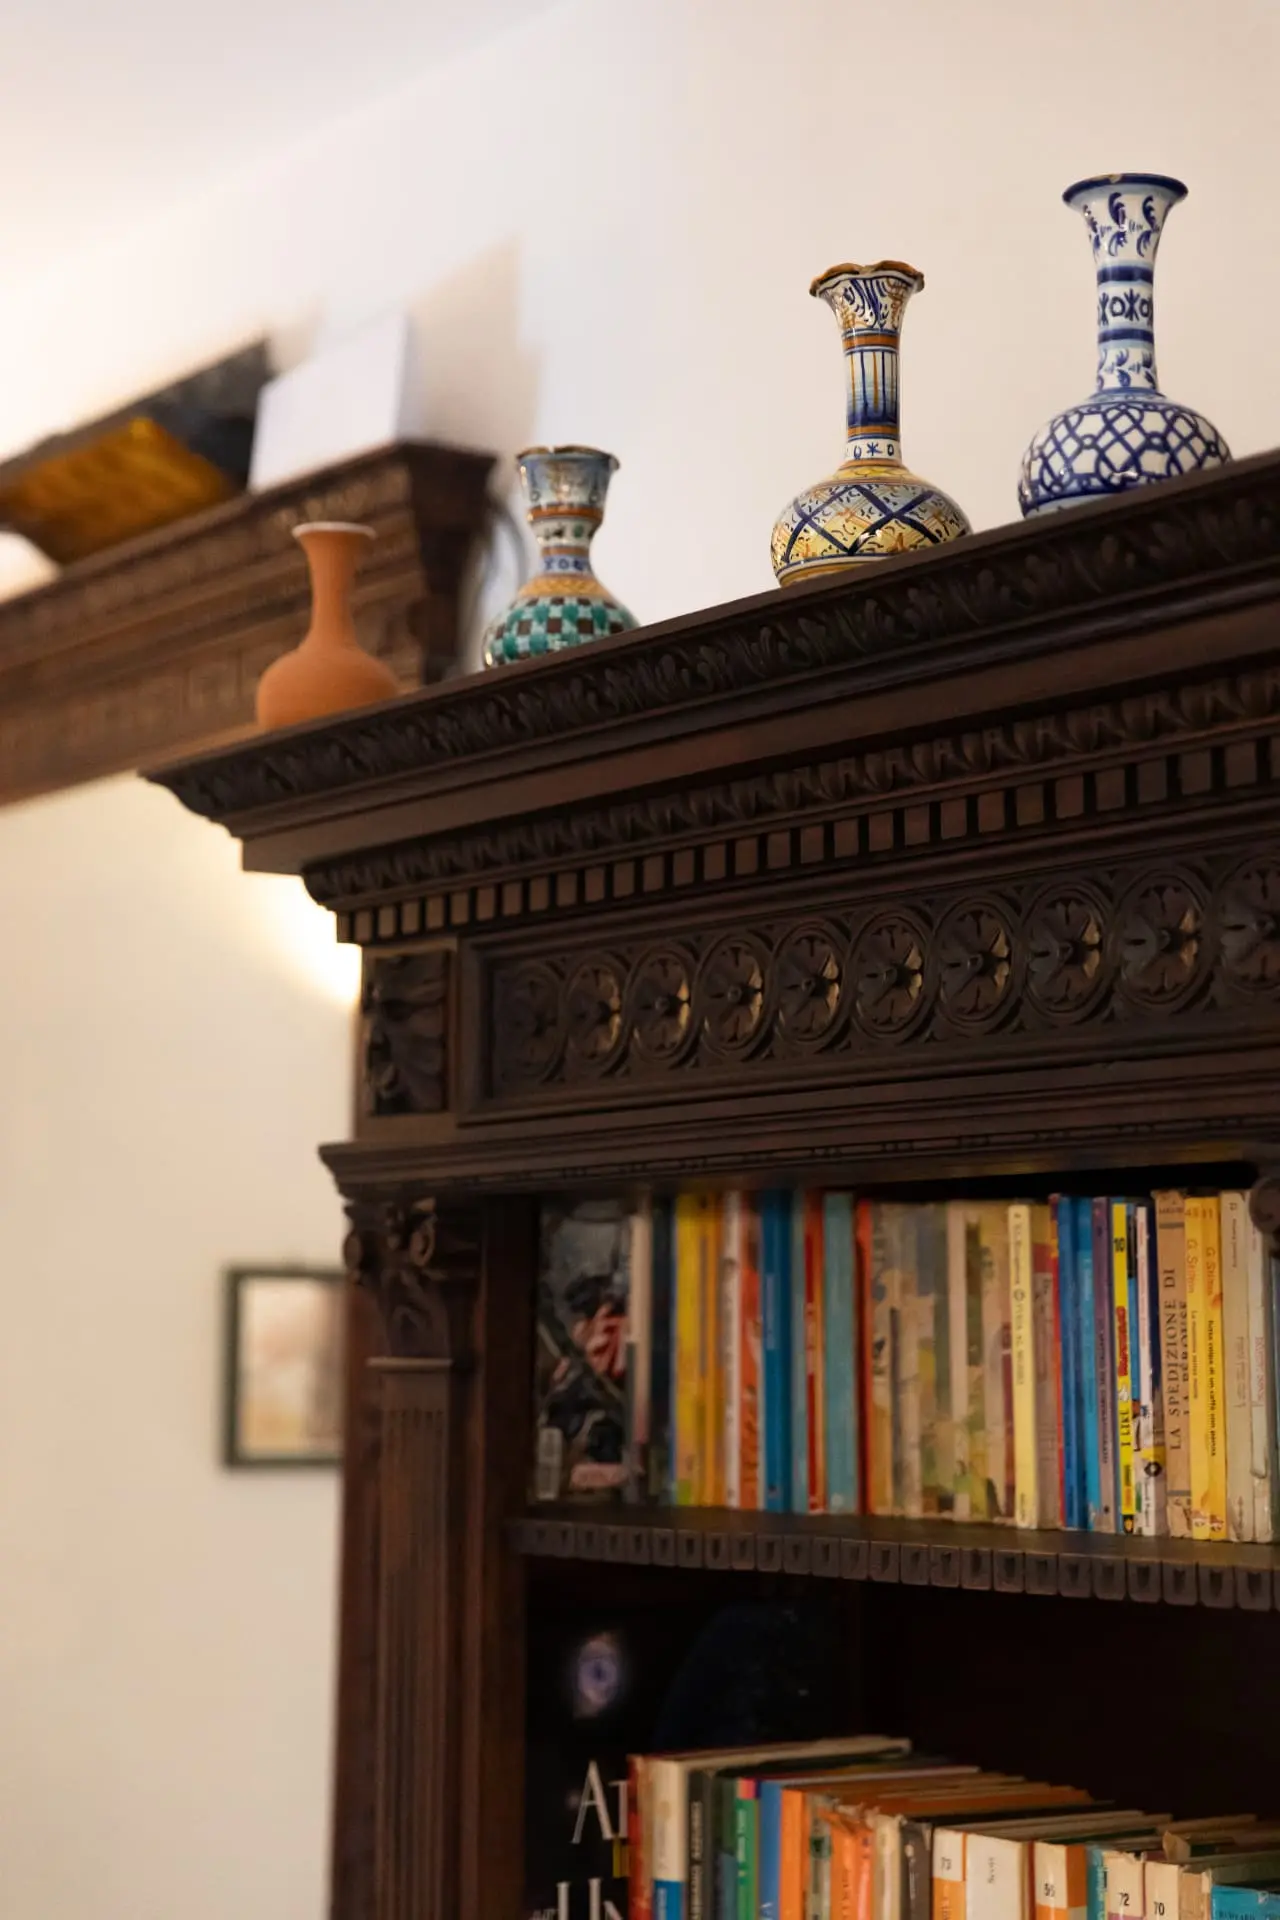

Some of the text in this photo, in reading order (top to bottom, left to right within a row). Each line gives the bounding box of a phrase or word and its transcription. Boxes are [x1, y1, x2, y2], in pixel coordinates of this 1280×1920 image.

[1162, 1268, 1182, 1451] LA SPEDIZIONE DI
[1118, 1892, 1130, 1907] 72
[1153, 1901, 1166, 1917] 70
